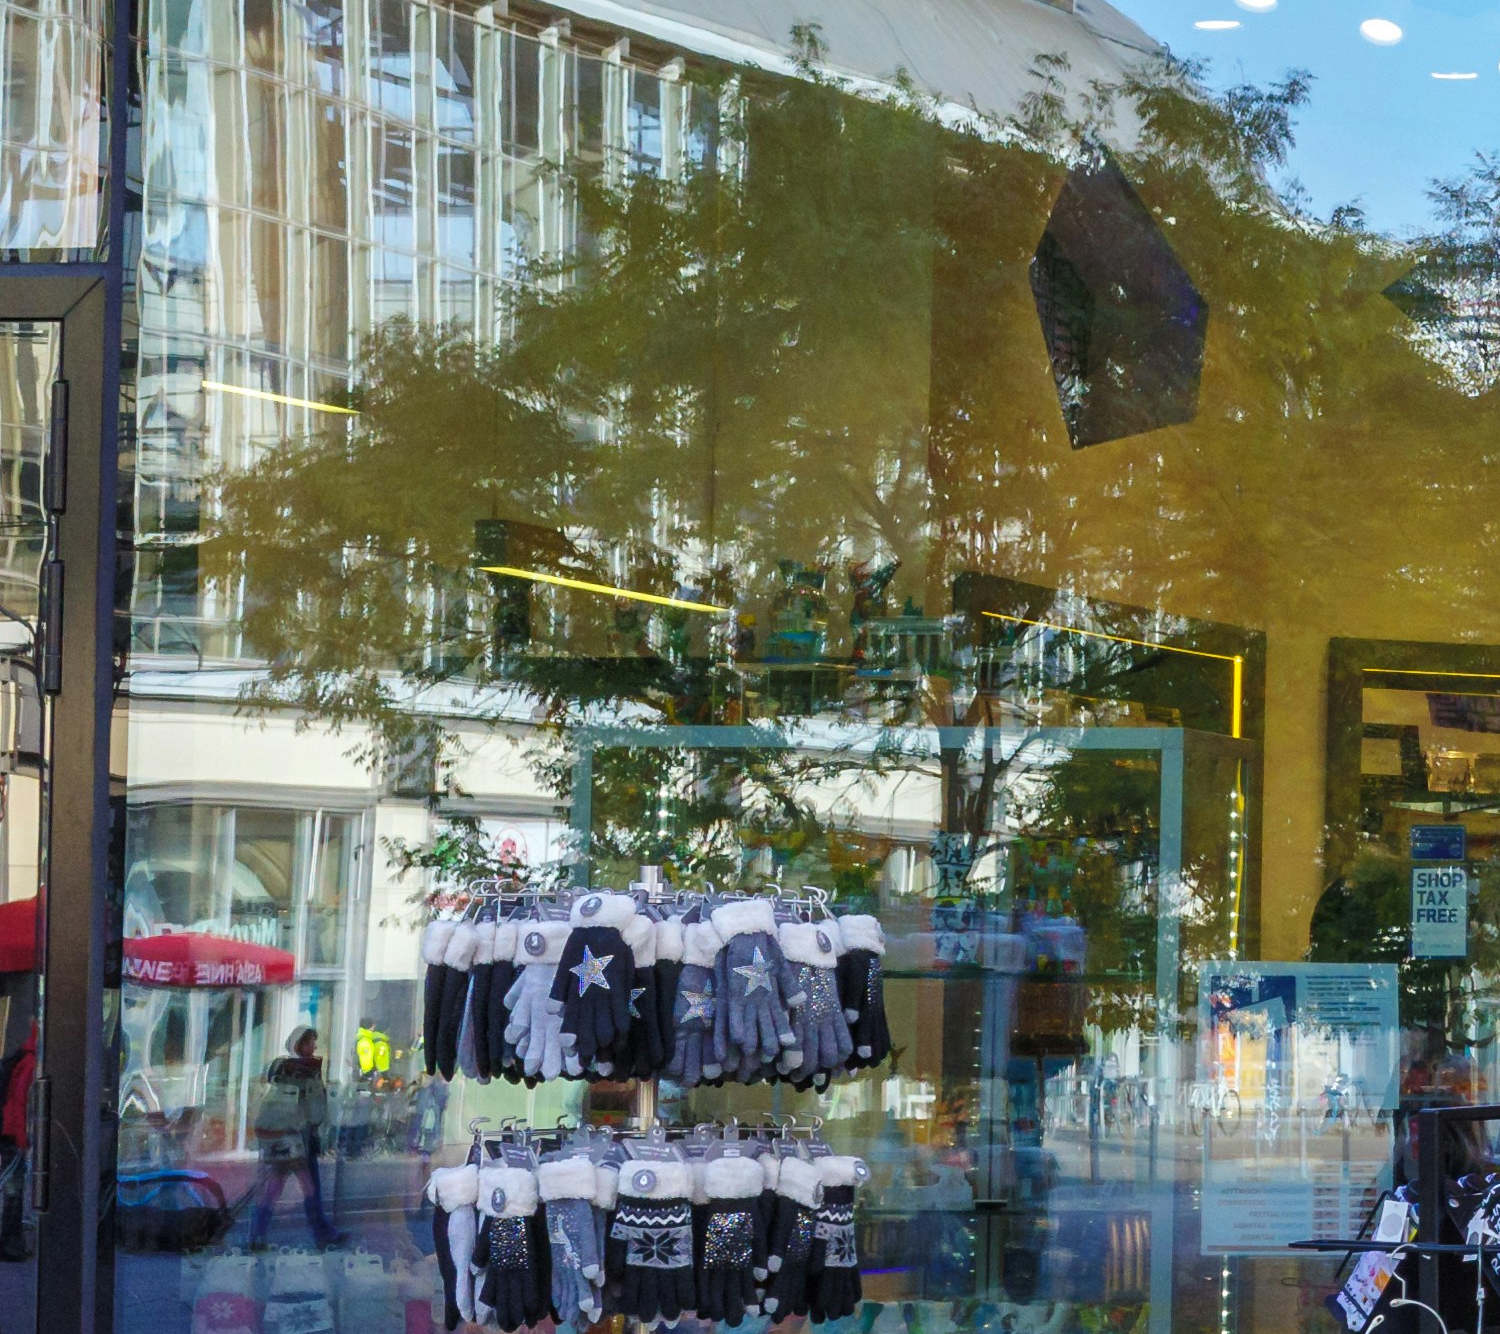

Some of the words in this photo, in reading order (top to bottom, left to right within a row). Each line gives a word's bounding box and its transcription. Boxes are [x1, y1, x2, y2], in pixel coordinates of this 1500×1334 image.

[1417, 872, 1463, 888] SHOP
[1417, 890, 1449, 905] TAX
[1417, 909, 1458, 923] FREE
